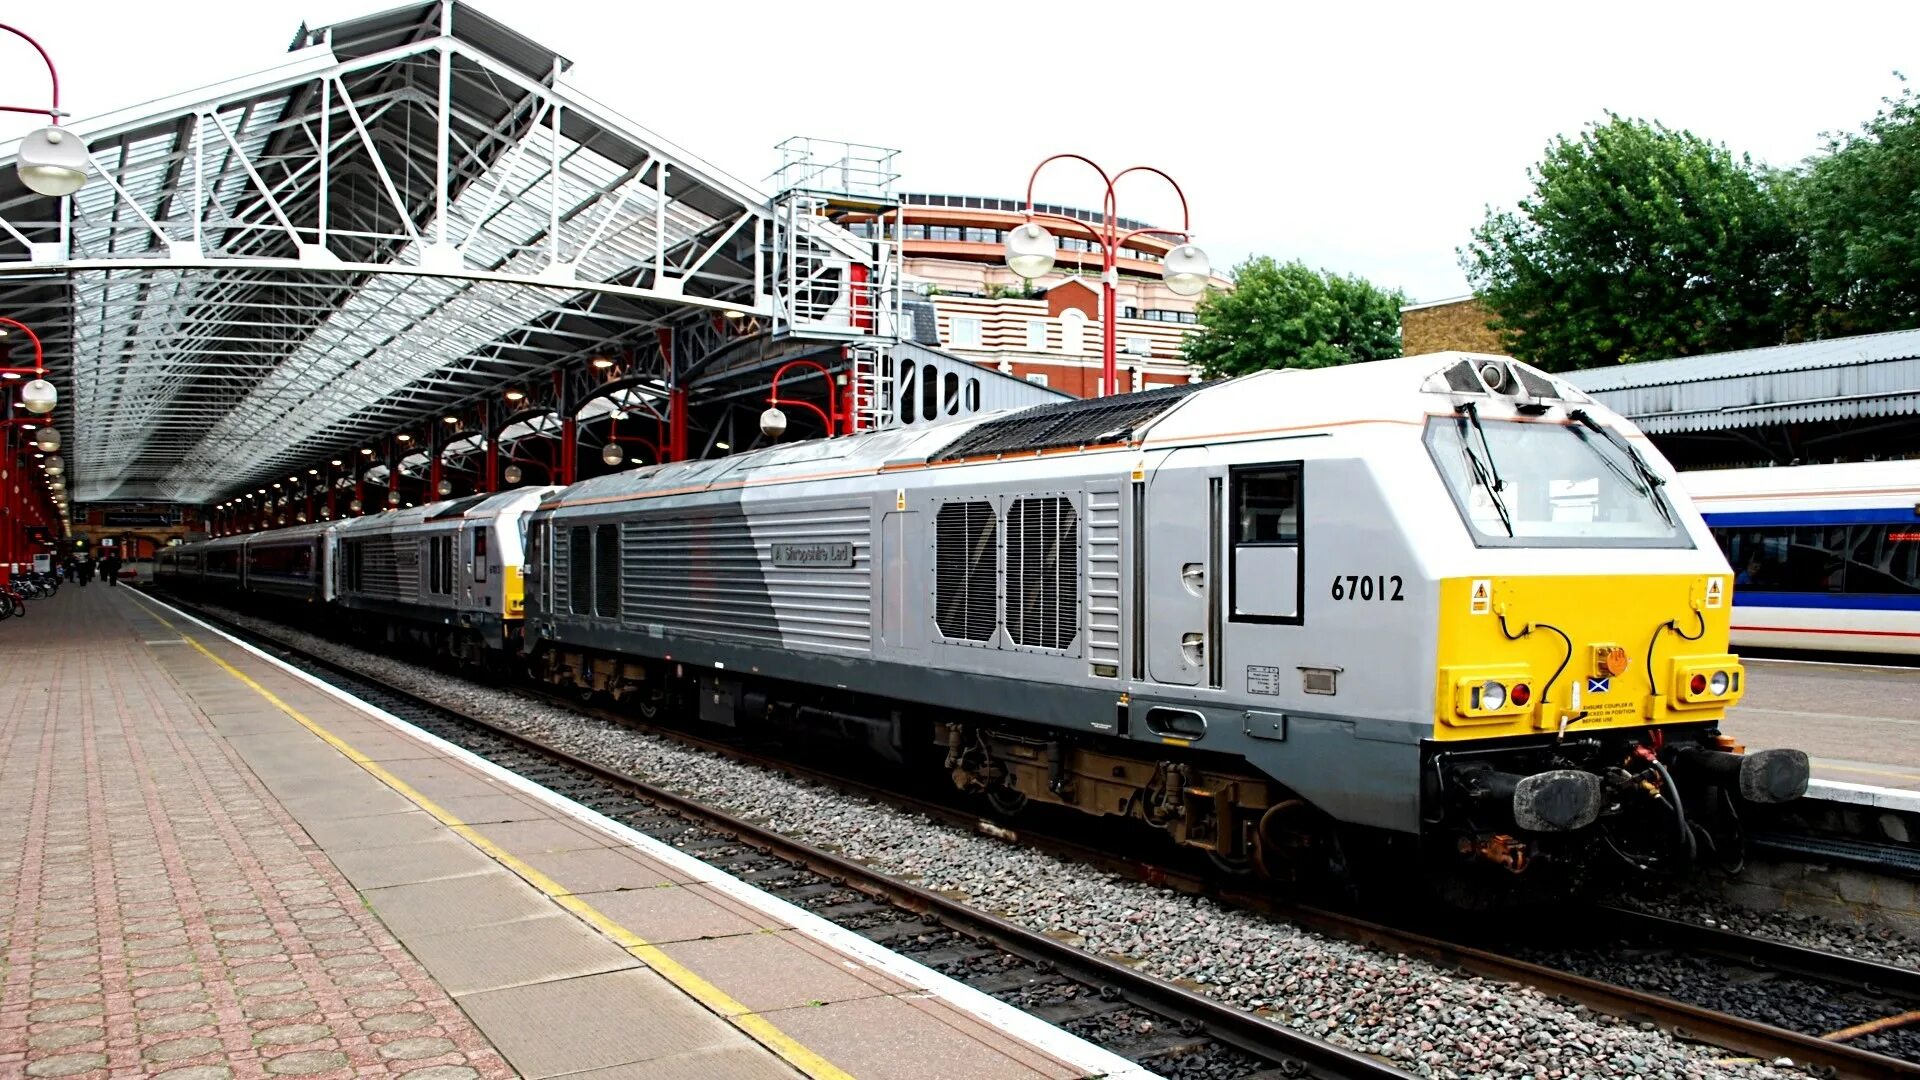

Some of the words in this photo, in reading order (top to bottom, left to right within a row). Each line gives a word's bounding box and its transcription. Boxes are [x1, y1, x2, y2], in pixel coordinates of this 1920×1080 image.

[785, 545, 828, 564] Shropshire
[831, 545, 848, 561] Lad
[1331, 575, 1404, 601] 67012
